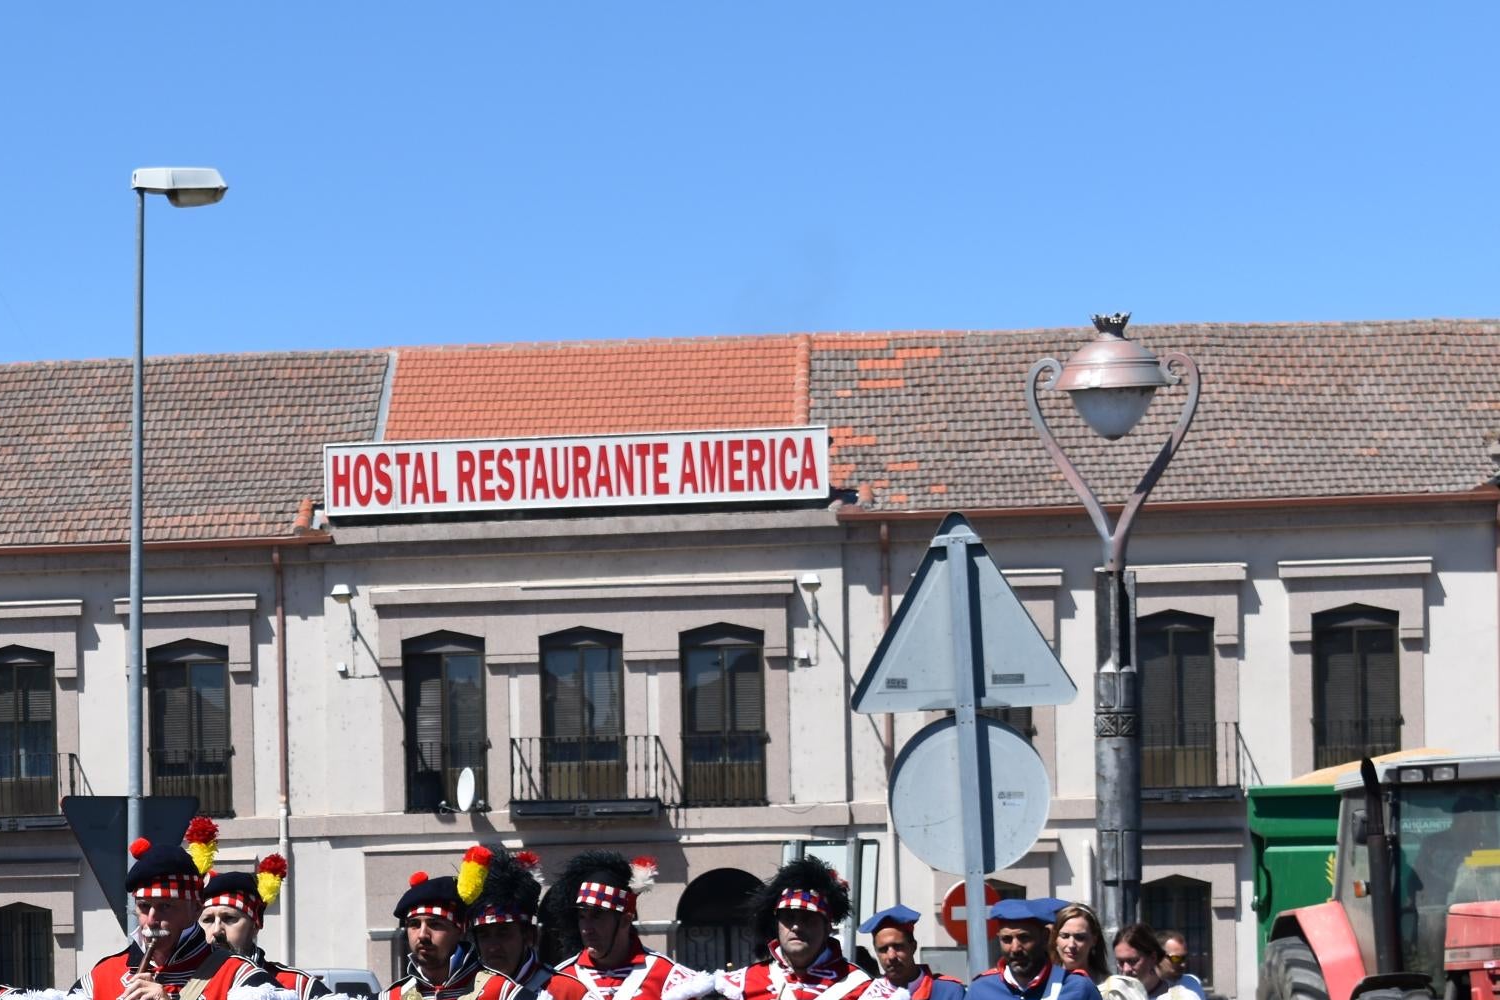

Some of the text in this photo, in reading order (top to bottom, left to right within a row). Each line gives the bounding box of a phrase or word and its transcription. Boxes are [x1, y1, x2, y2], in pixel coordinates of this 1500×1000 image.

[332, 437, 819, 507] HOSTAL RESTAURANTE AMERICA
